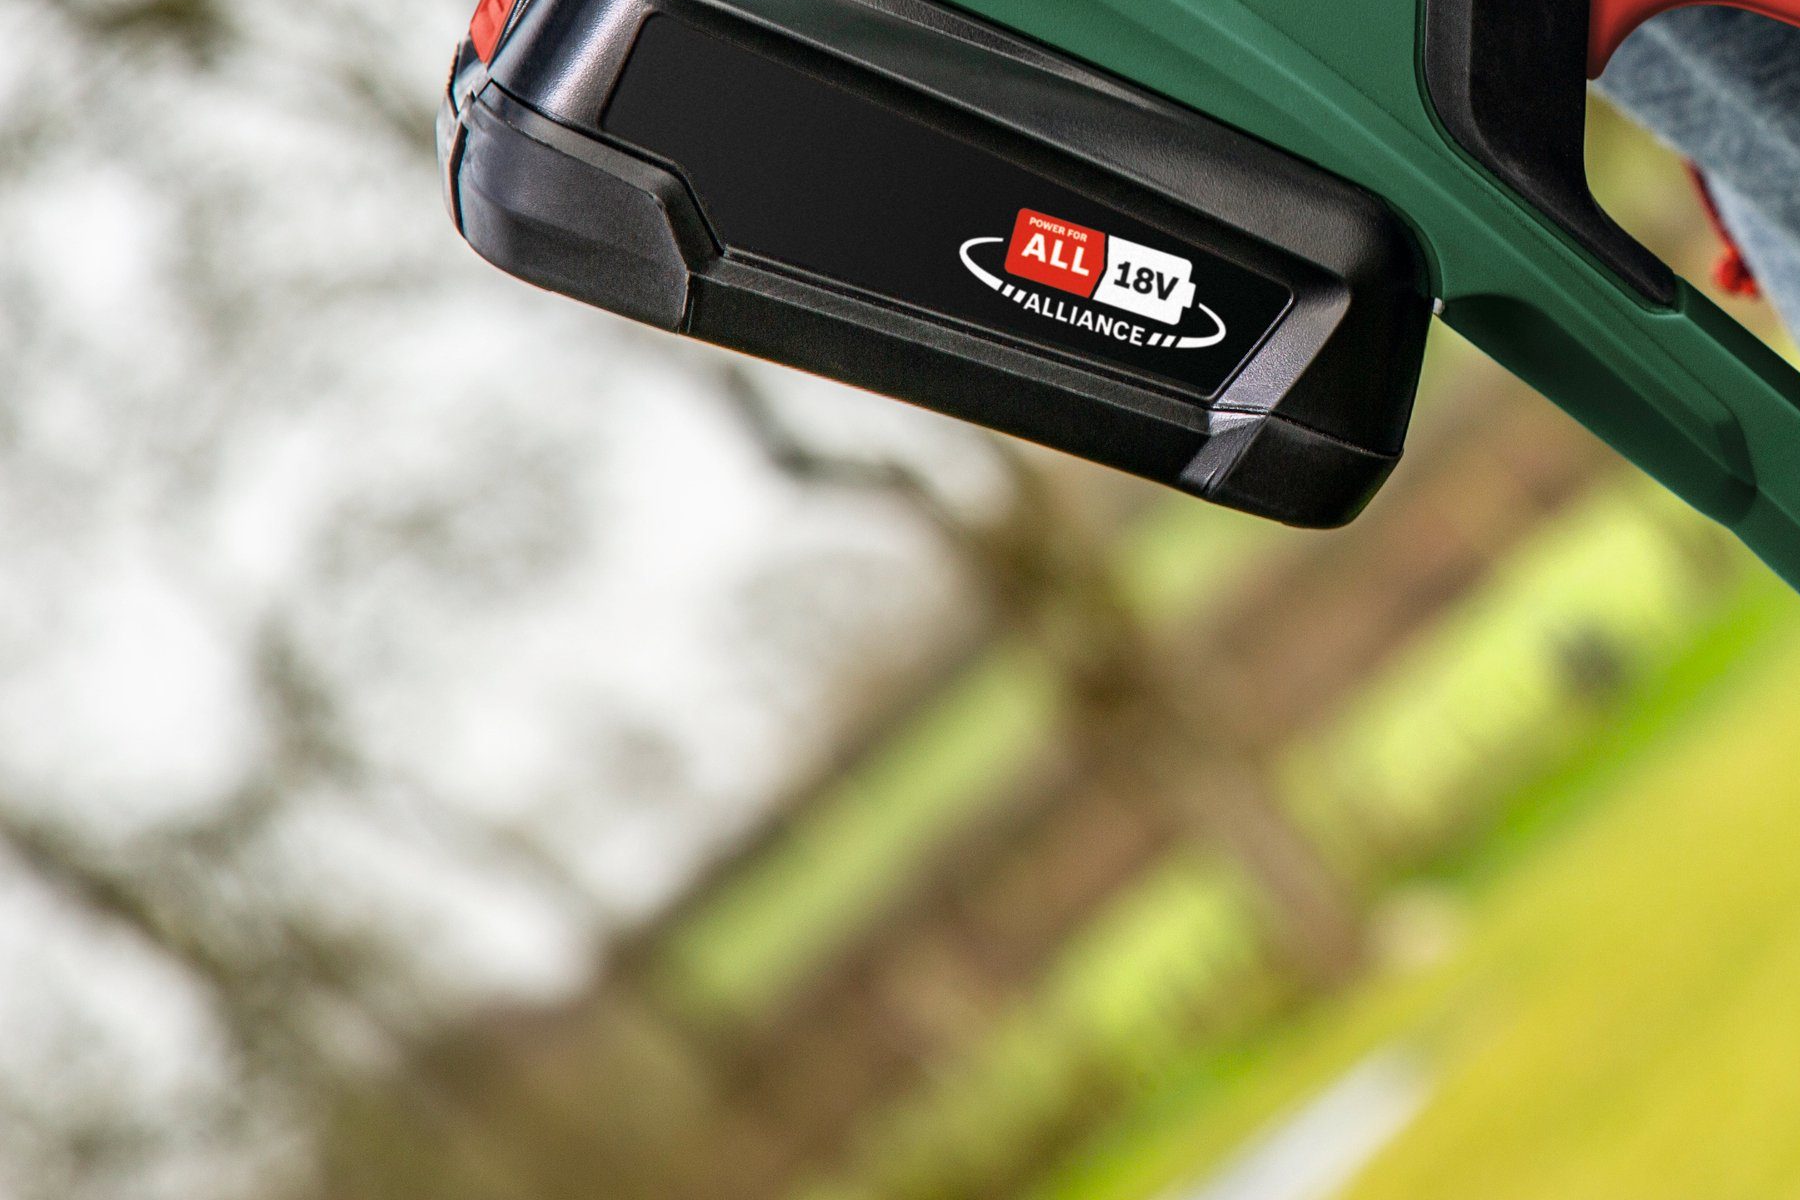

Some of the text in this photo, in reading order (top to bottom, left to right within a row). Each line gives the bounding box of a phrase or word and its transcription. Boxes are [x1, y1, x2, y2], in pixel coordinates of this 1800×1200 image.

[1029, 217, 1087, 242] POWER FOR
[1022, 233, 1090, 276] ALL
[1113, 261, 1179, 301] 18V
[1024, 293, 1146, 346] ALLIANCE
